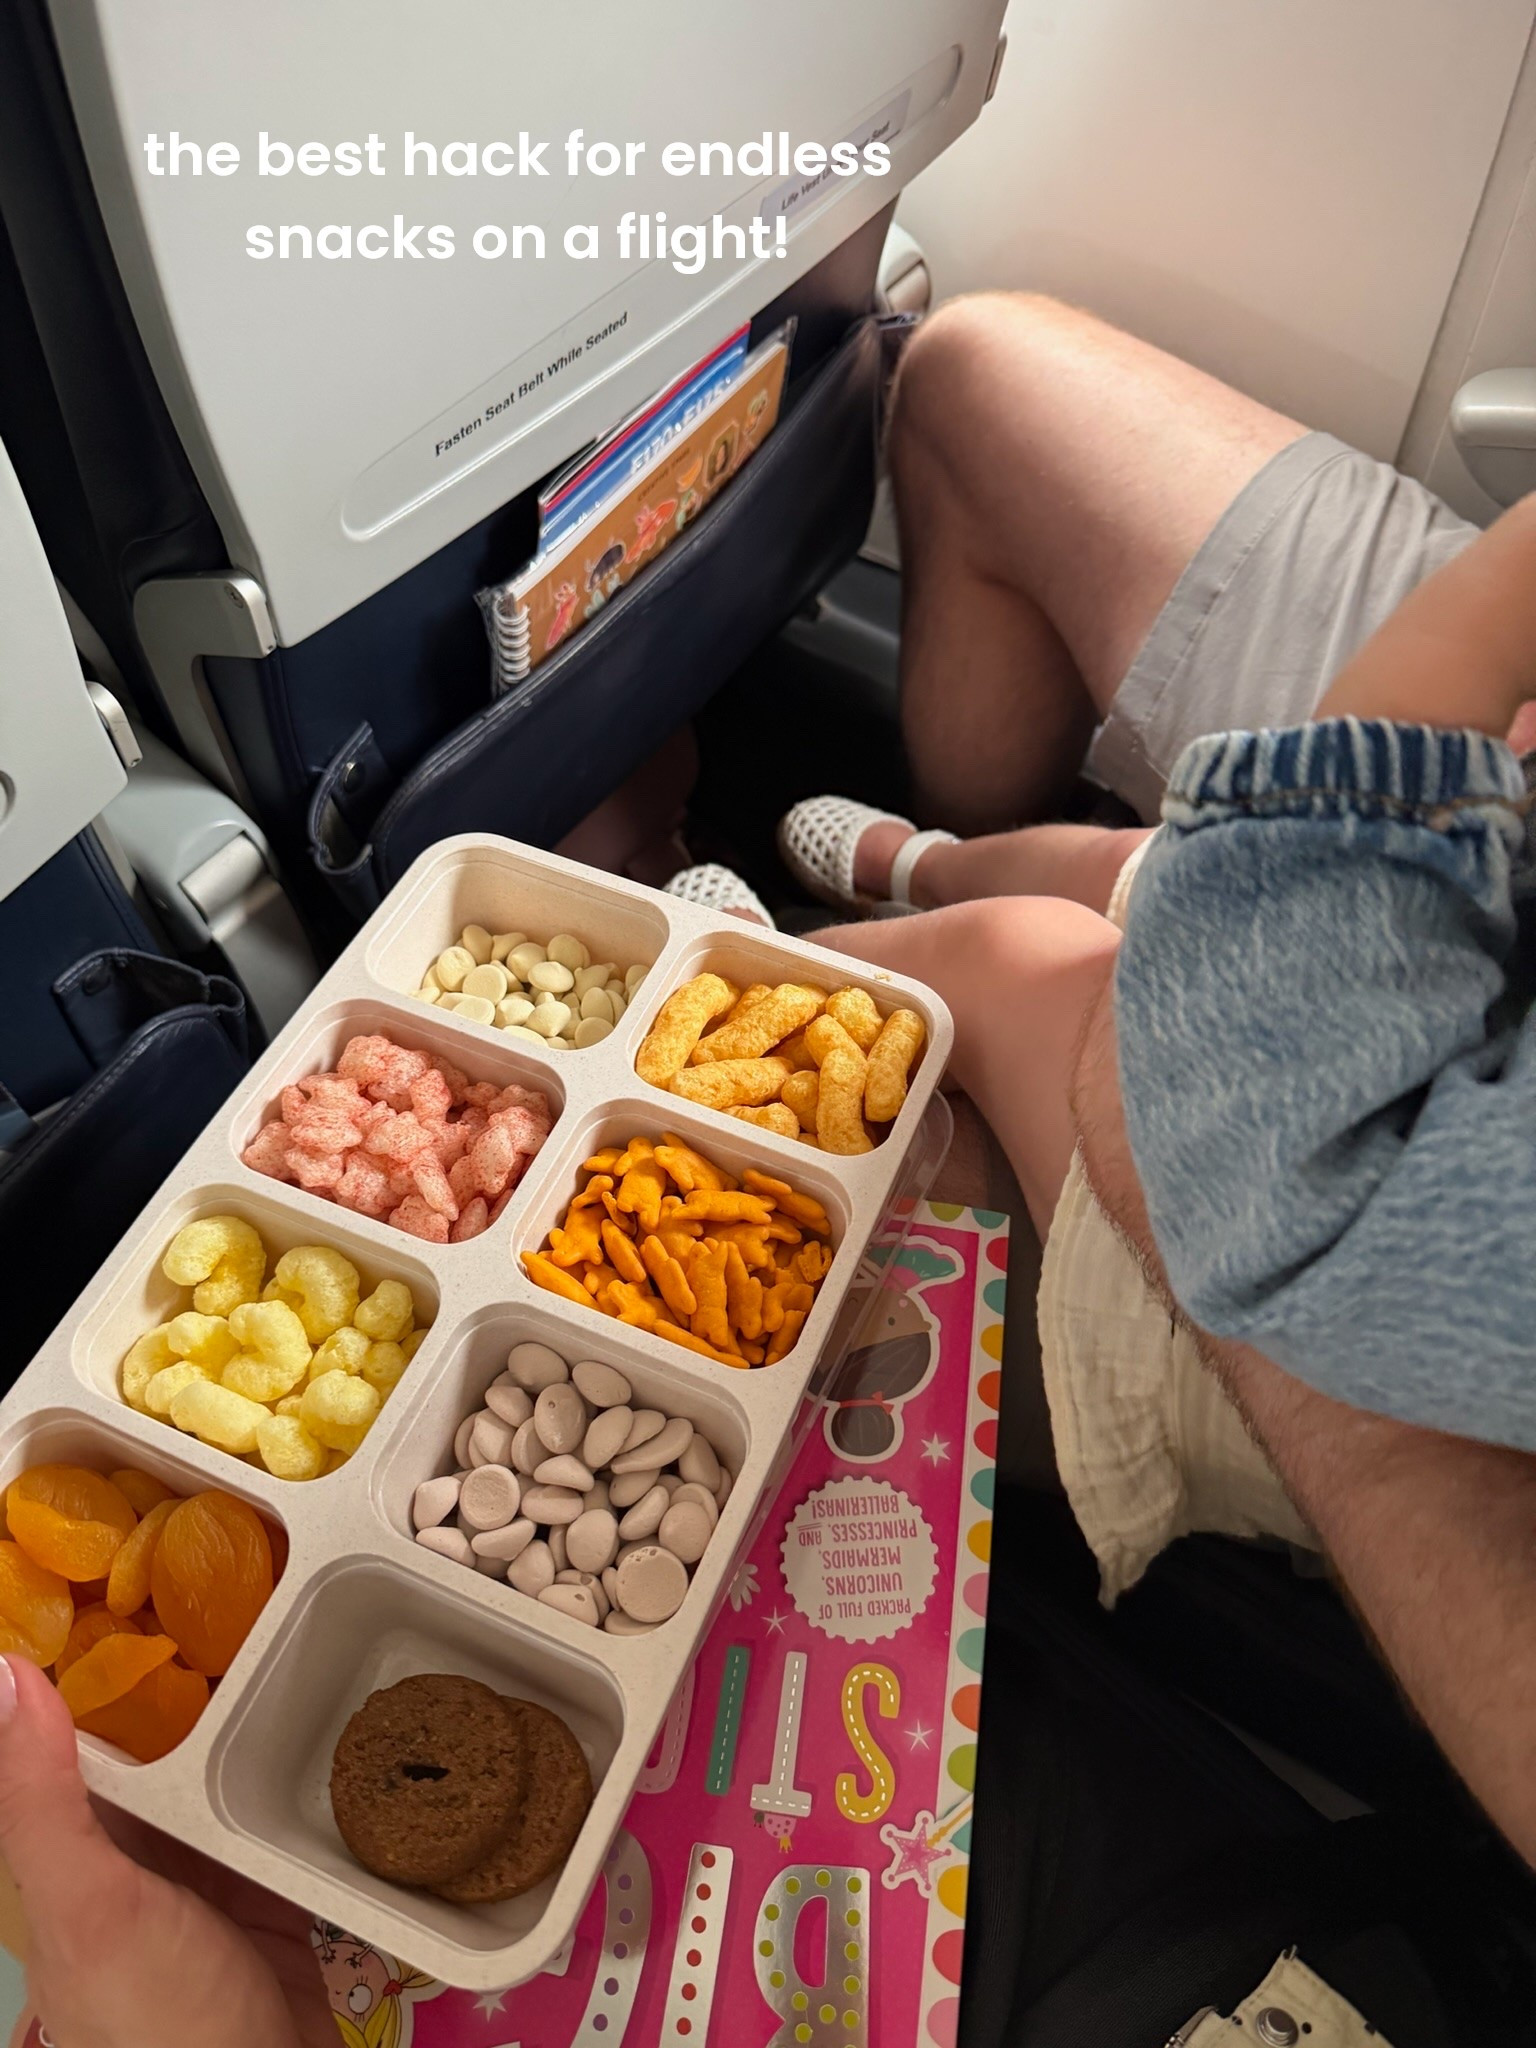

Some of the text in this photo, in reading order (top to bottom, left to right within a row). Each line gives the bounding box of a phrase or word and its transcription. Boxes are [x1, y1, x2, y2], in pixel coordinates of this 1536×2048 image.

[434, 311, 628, 458] Fasten Seat Belt While Seated
[811, 1494, 900, 1519] BALLERINAS!
[798, 1530, 822, 1547] AND
[818, 1597, 911, 1620] PACKED FULL OF
